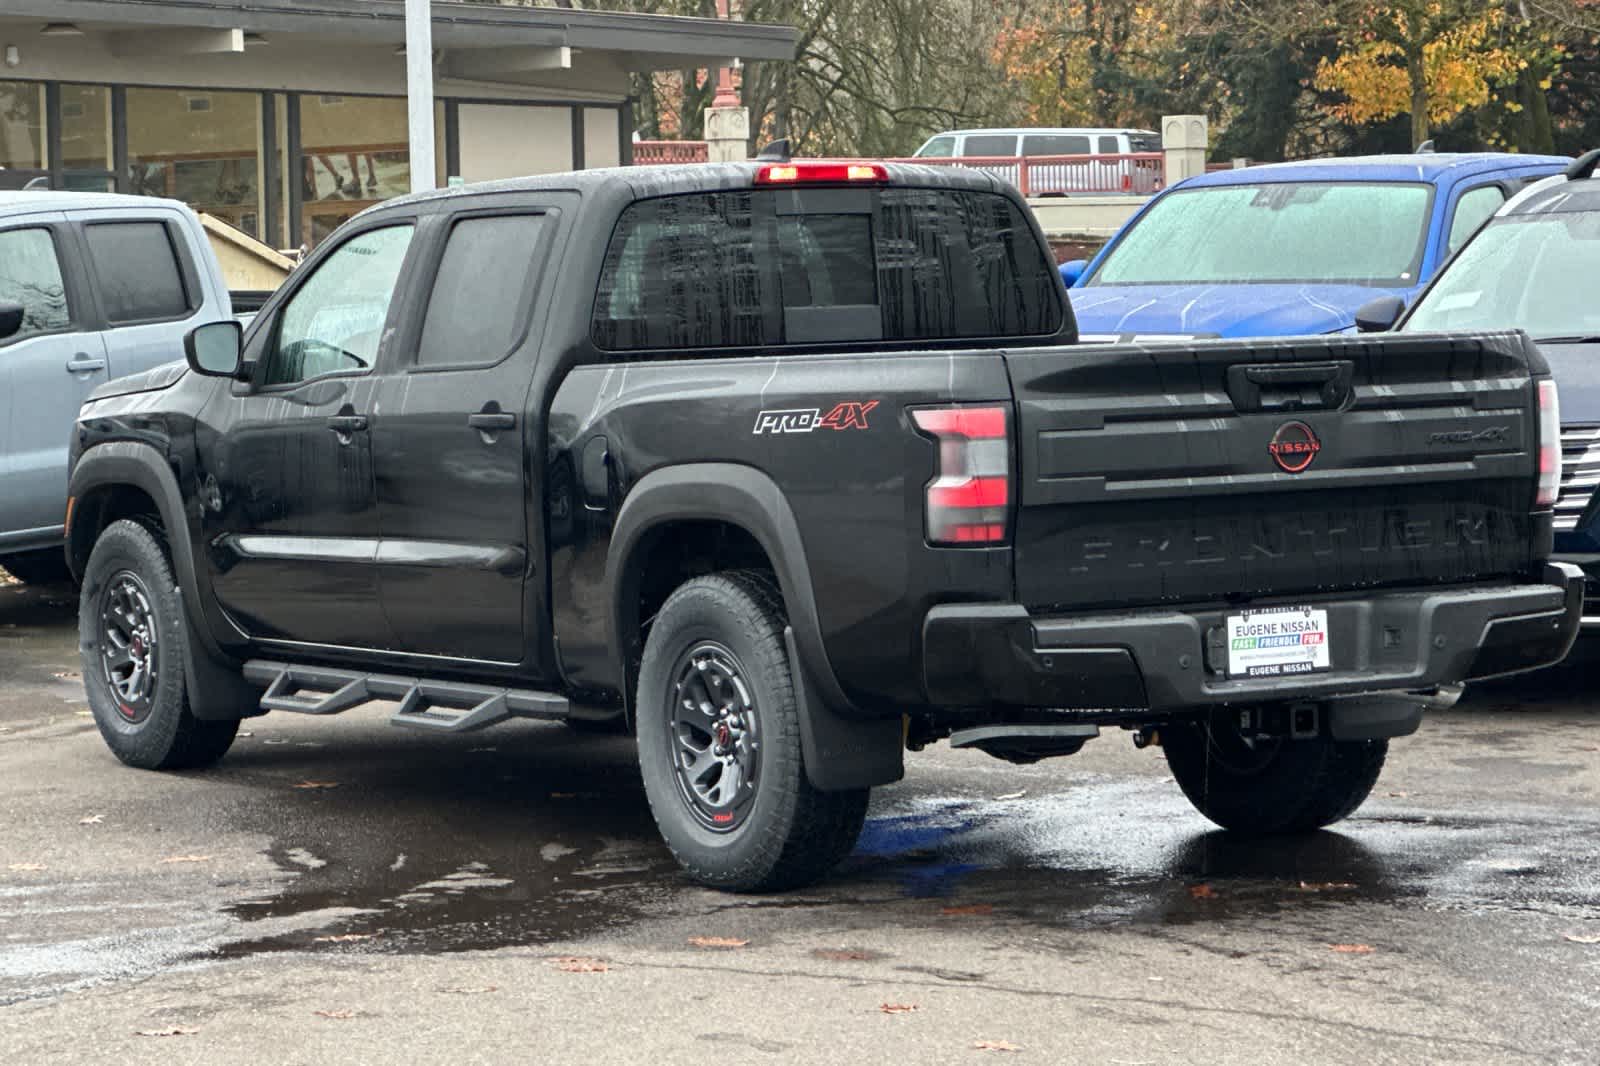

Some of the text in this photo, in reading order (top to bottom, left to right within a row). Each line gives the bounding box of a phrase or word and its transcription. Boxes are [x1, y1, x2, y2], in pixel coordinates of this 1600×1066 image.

[1269, 441, 1320, 453] NISSAN
[1236, 620, 1319, 637] EUGENE NISSAN
[1249, 663, 1312, 676] EUGENE NISSAN
